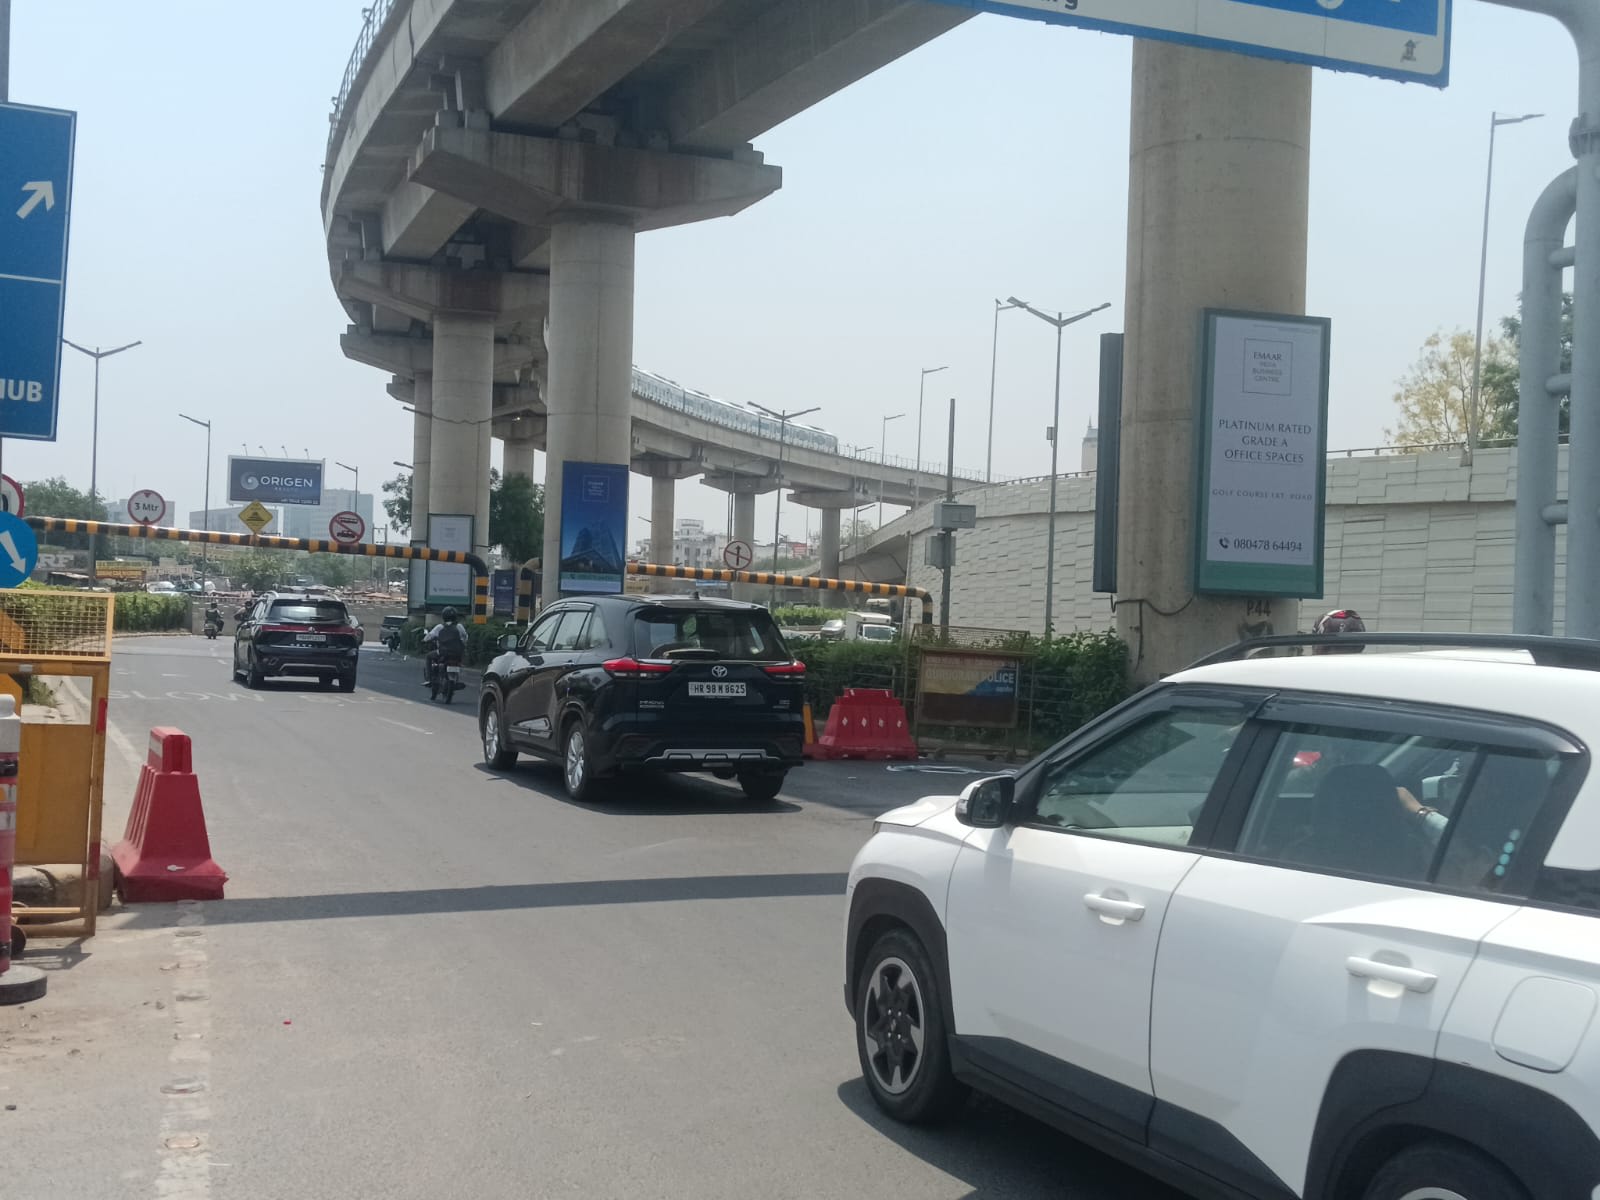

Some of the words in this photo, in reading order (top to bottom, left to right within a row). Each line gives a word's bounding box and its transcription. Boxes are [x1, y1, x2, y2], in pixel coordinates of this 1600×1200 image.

[1253, 351, 1282, 361] EMAAR
[1219, 419, 1275, 432] PLATINUM
[1278, 423, 1312, 434] RATED
[1242, 435, 1279, 447] GRADE
[1281, 438, 1288, 448] A
[1224, 449, 1263, 460] OFFICE
[1265, 451, 1304, 463] SPACES
[260, 476, 313, 488] ORIGEN
[134, 502, 140, 511] 3
[142, 503, 160, 512] Mtr
[1233, 538, 1270, 551] 080478
[1272, 540, 1303, 552] 64494
[983, 670, 1015, 684] POLICE
[694, 684, 704, 694] HR
